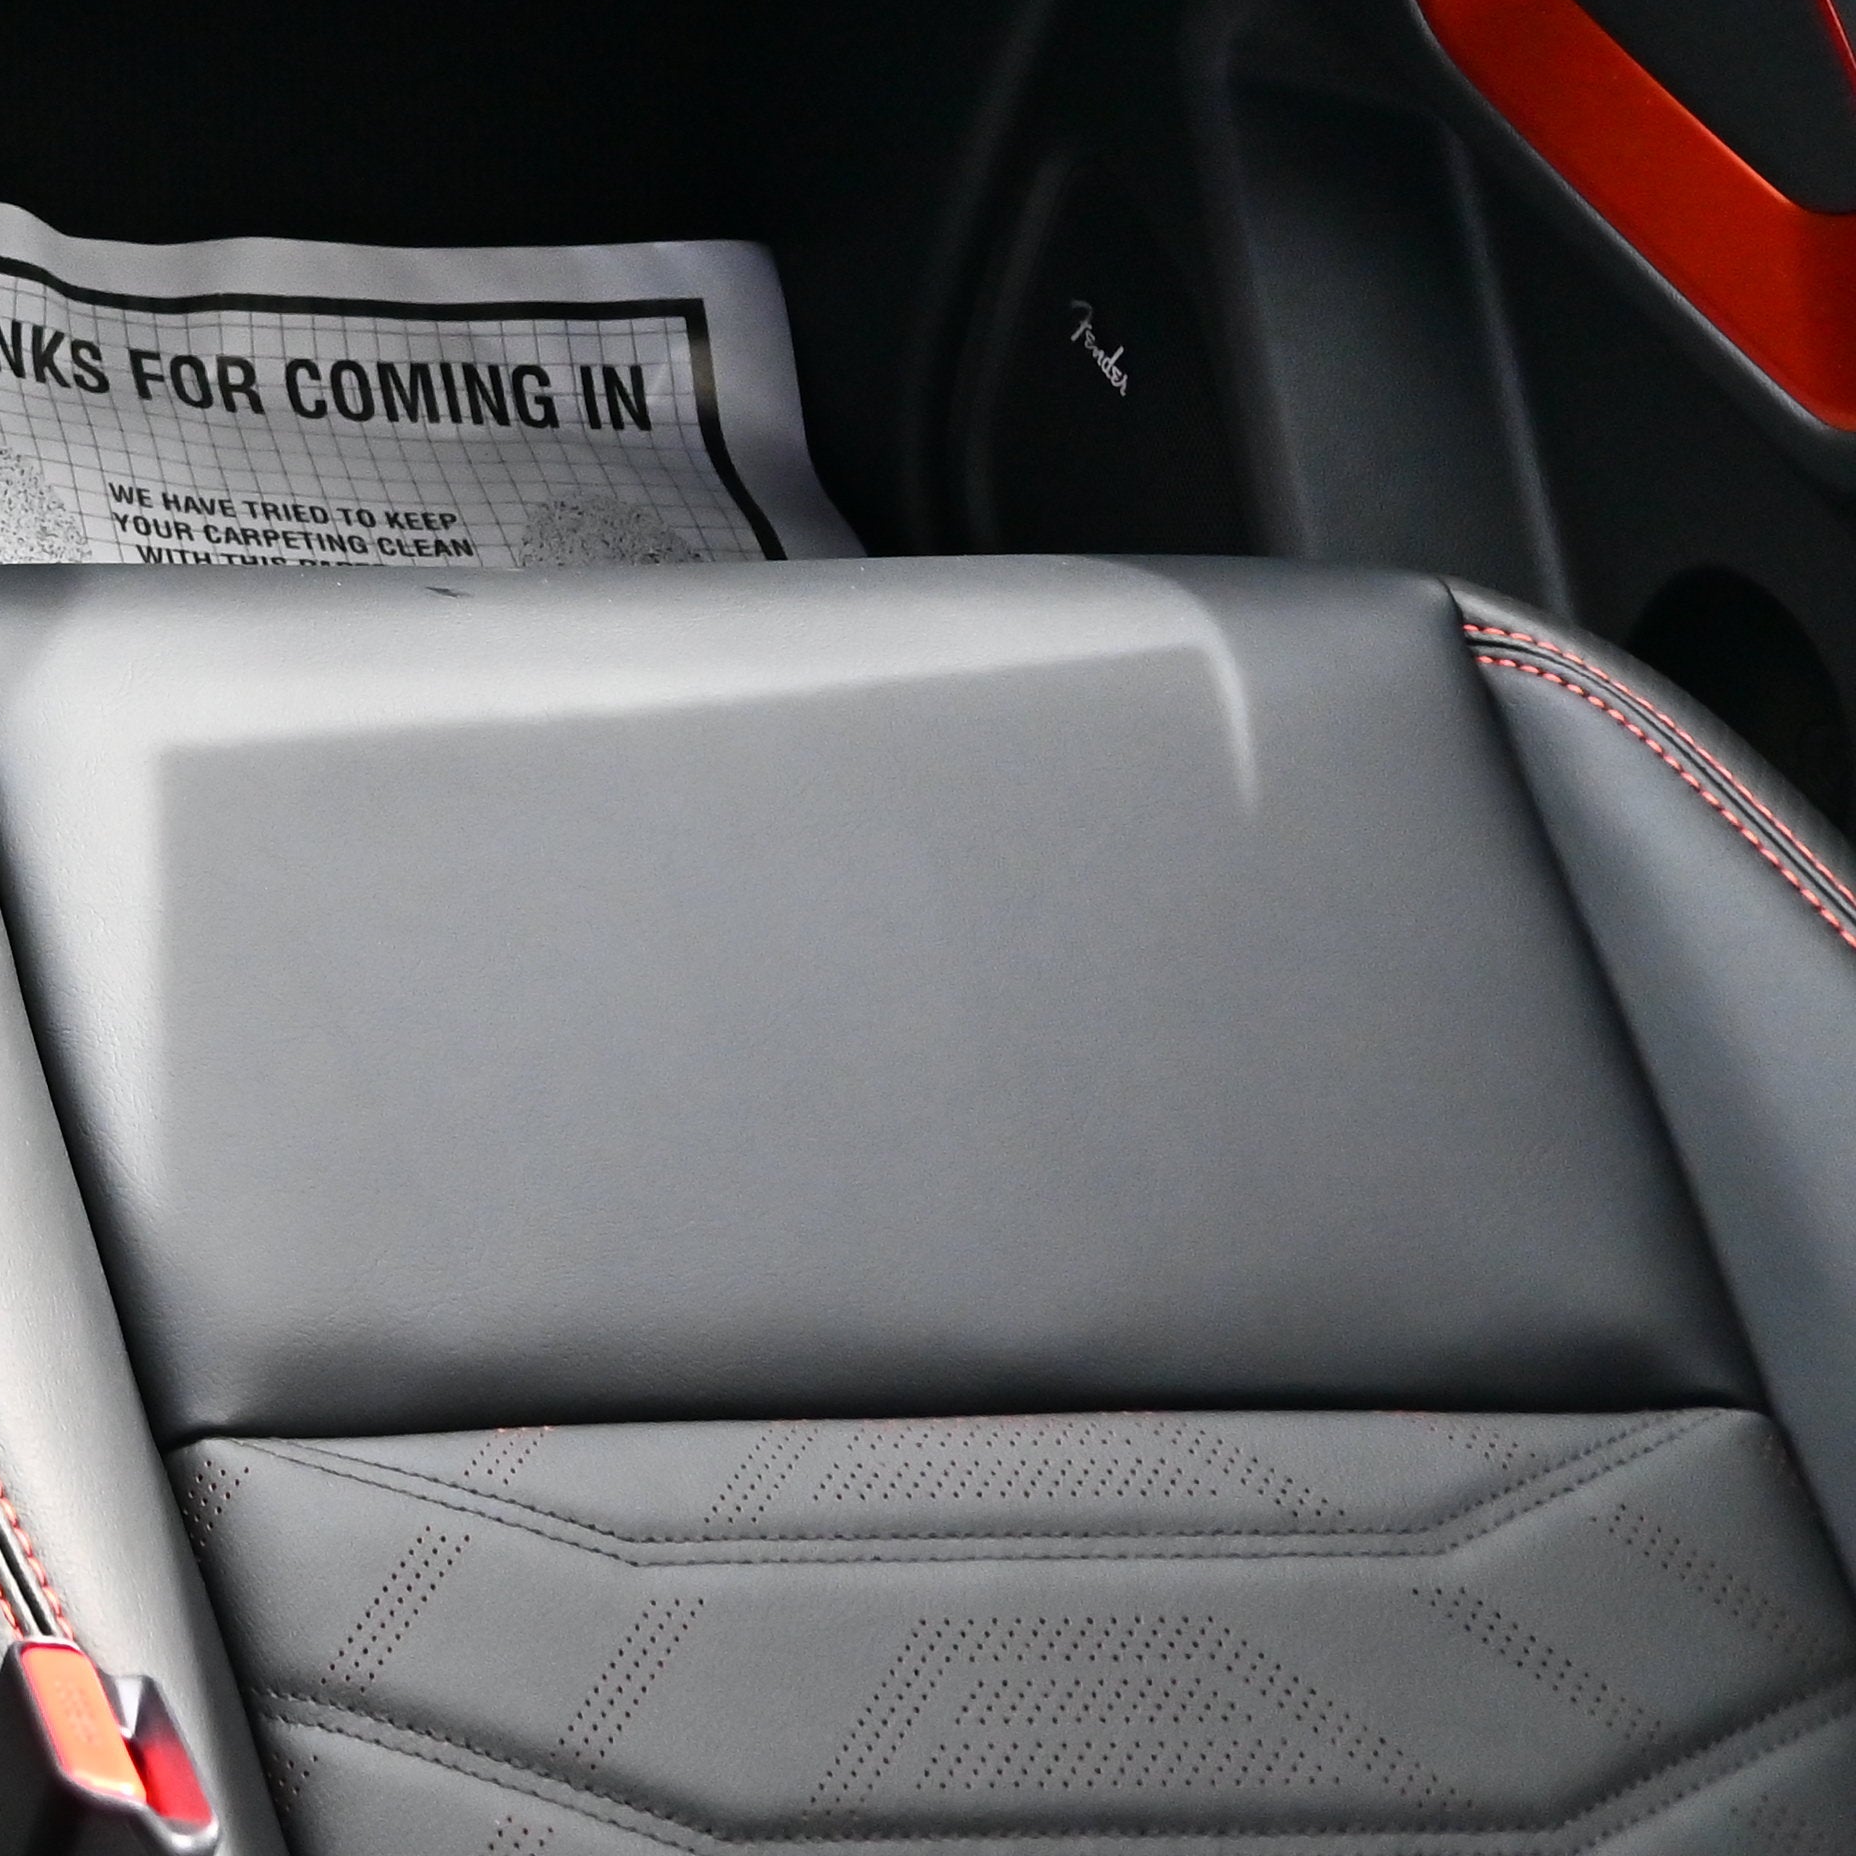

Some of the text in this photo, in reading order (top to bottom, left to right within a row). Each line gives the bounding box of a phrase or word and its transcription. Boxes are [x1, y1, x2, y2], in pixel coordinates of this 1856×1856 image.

[129, 350, 264, 414] FOR
[287, 360, 558, 431] COMING
[580, 365, 652, 432] IN
[108, 482, 457, 531] WE HAVE TRIED TO KEEP
[115, 512, 474, 558] YOUR CARPETING CLEAN
